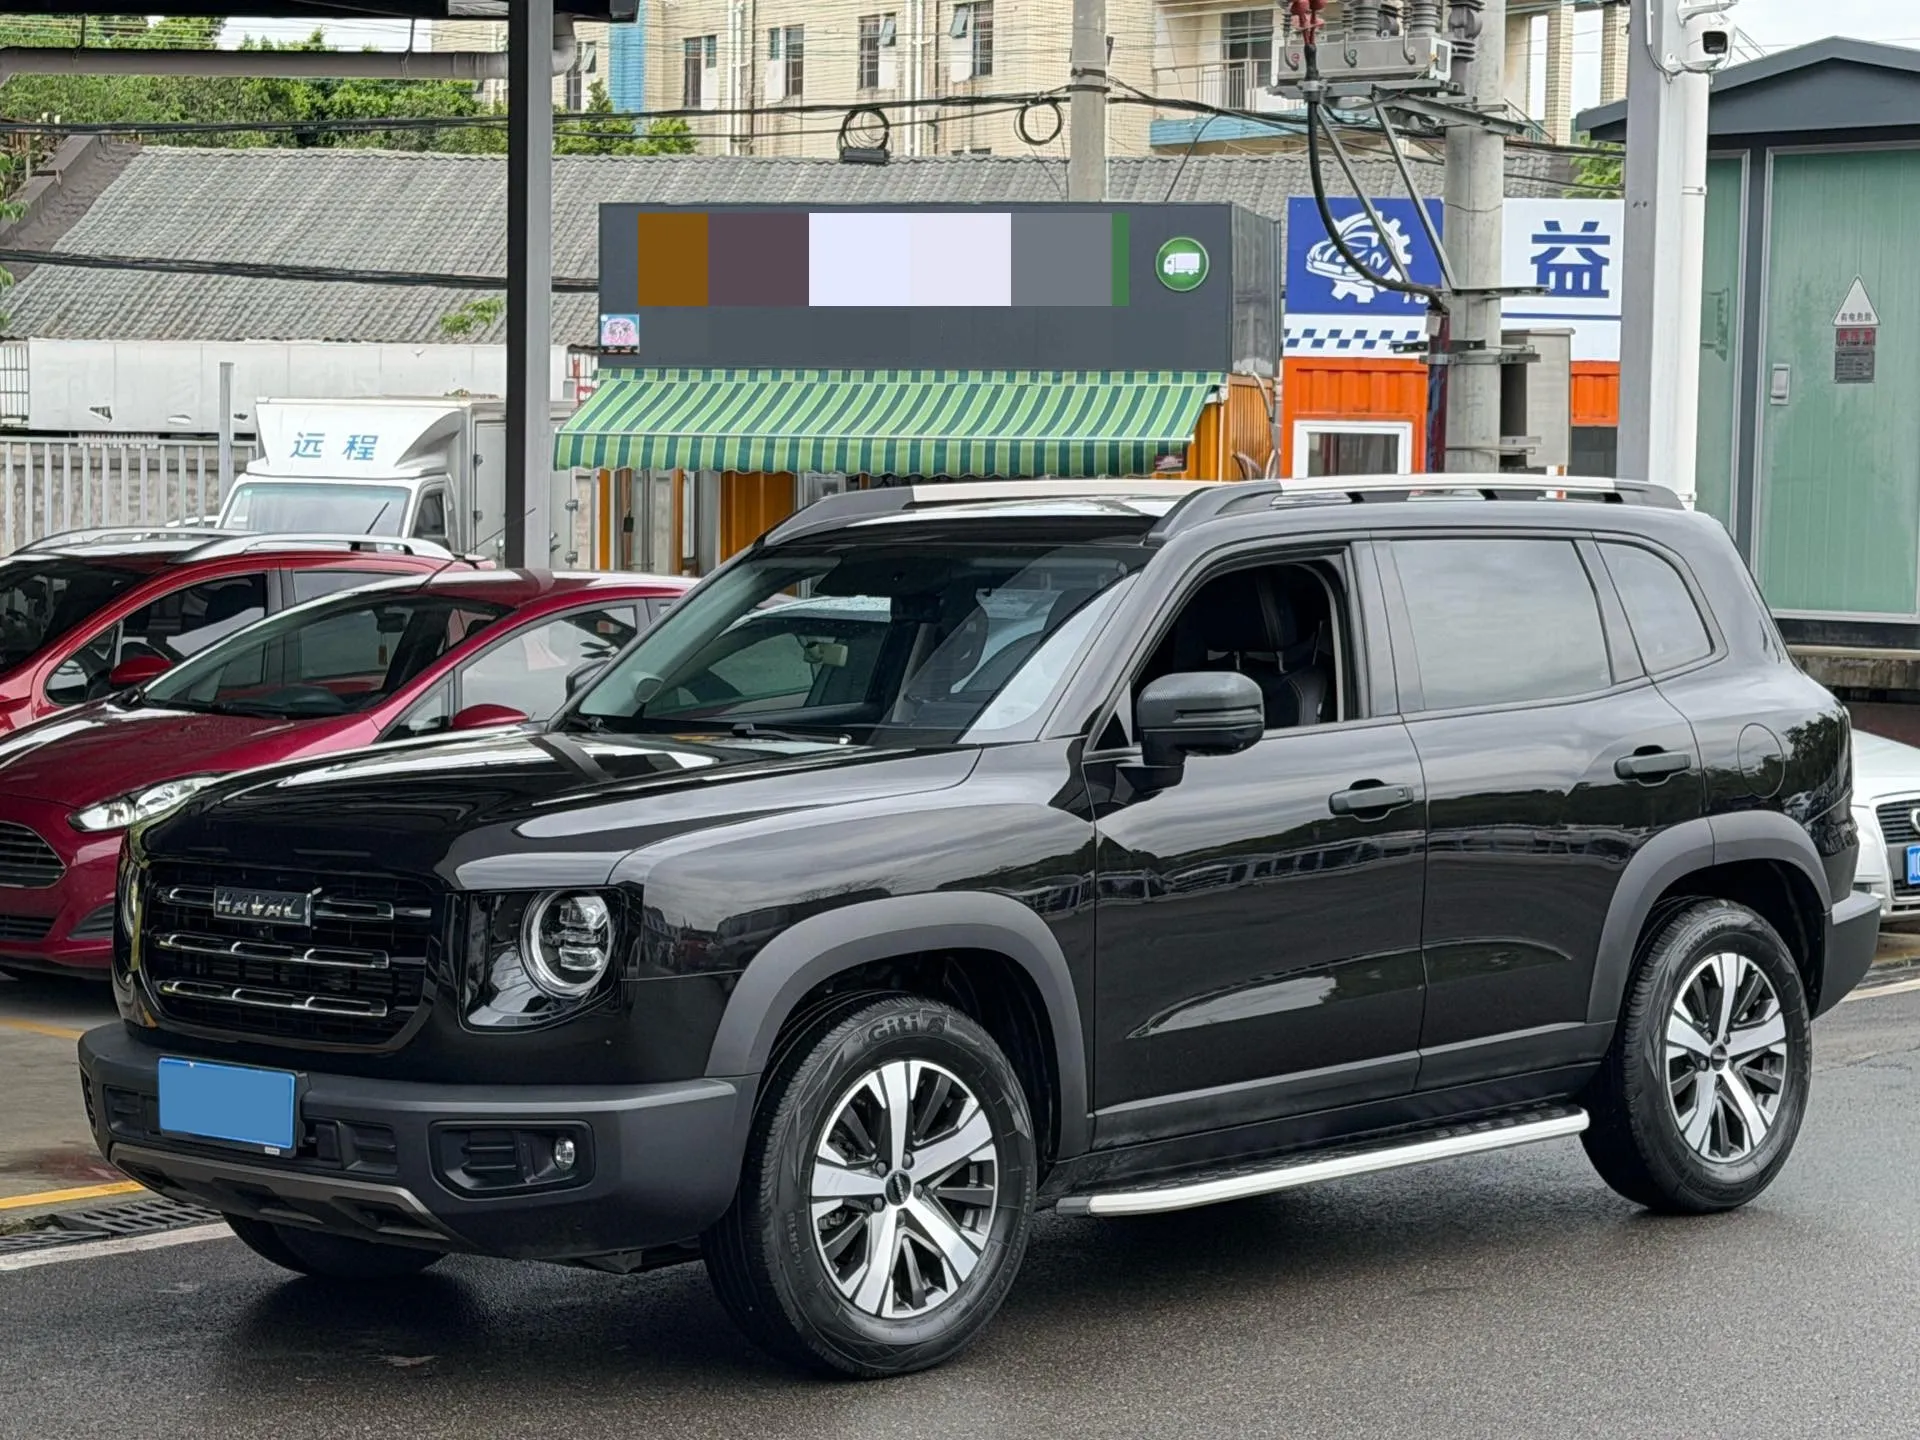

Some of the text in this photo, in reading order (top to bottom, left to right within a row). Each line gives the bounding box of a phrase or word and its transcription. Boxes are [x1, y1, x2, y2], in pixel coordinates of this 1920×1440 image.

[1530, 220, 1610, 298] 益
[290, 431, 378, 461] 远程
[216, 891, 302, 919] HAVAL
[868, 1015, 918, 1041] Giti
